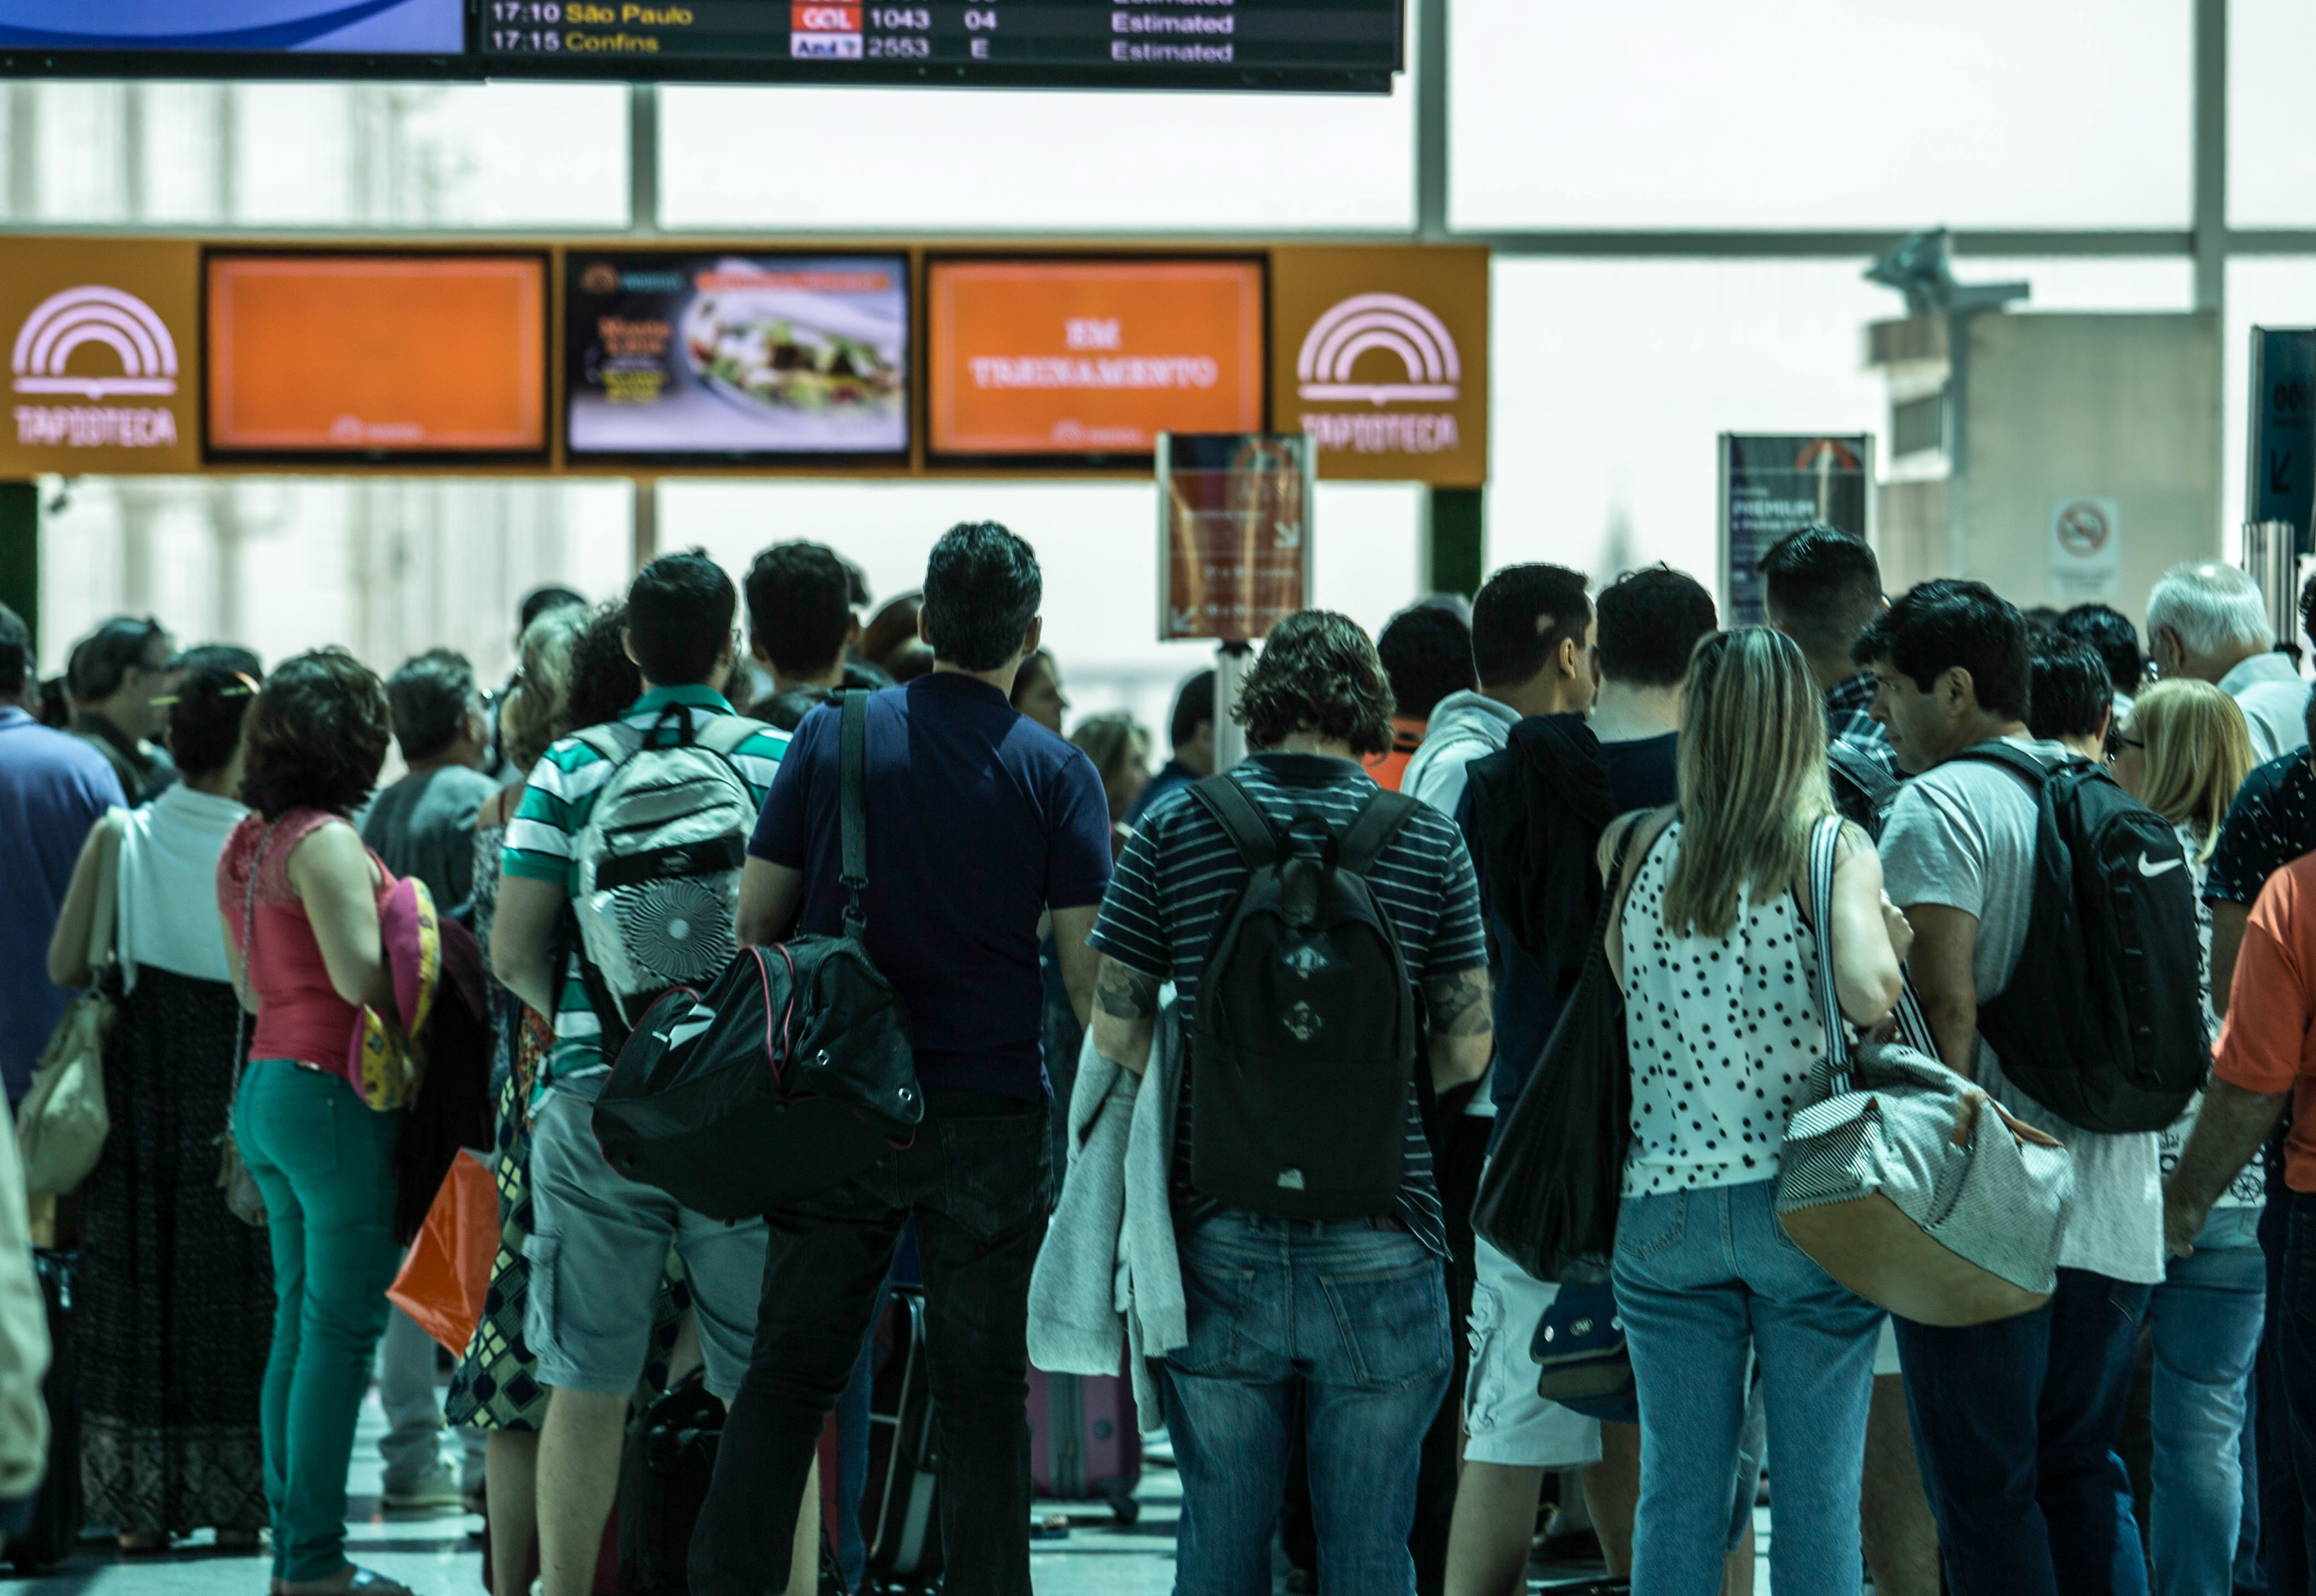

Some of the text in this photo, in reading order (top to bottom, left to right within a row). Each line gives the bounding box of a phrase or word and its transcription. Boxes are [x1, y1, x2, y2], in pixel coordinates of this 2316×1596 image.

[492, 2, 1234, 34] 17:10 São Paulo GOL 1043 04 Estimated
[492, 30, 560, 52] 17:15
[565, 31, 660, 53] Confins
[868, 37, 930, 57] 2553
[1112, 41, 1234, 63] Estimated
[1064, 318, 1122, 351] EM
[968, 355, 1219, 389] TREINAMENTO
